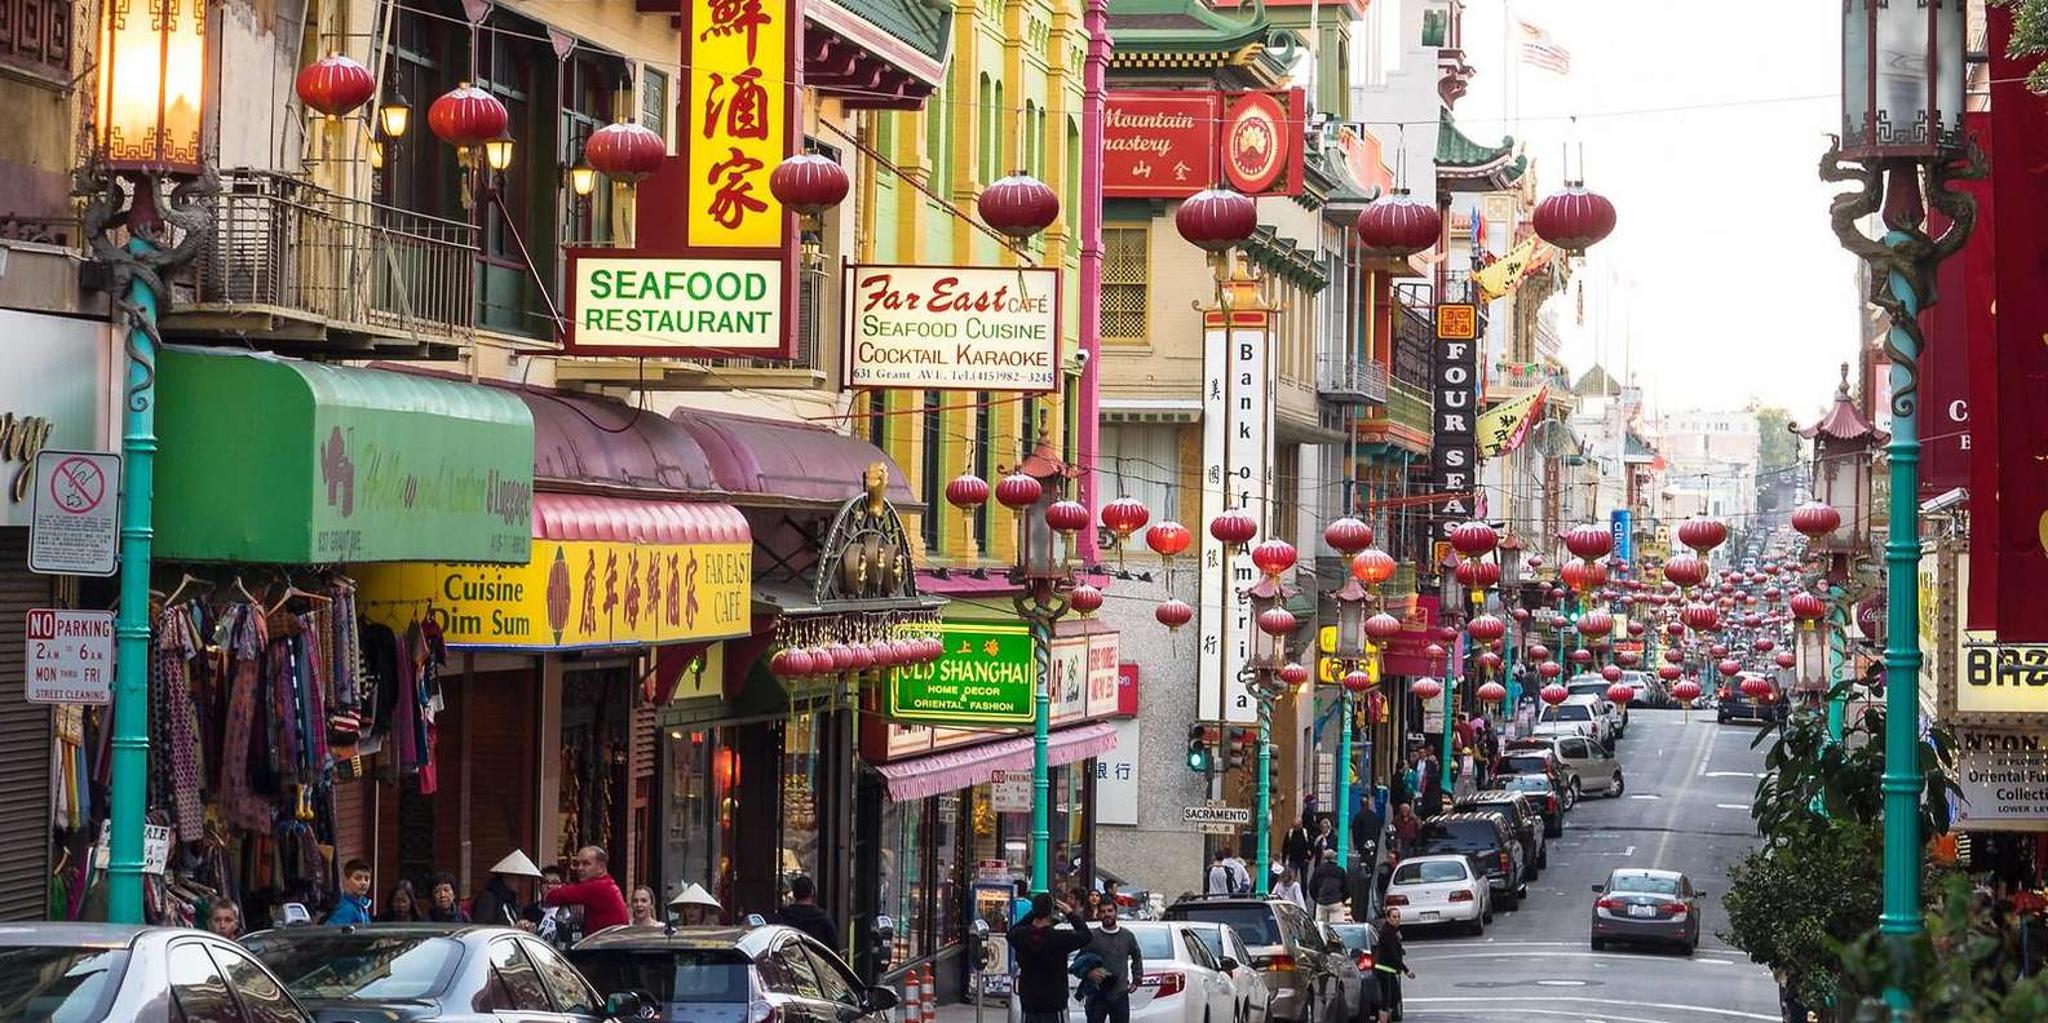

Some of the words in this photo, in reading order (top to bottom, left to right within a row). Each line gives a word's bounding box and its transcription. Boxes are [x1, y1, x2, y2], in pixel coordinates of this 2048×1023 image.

[700, 0, 771, 229] 鮮酒家
[1105, 108, 1194, 129] Mountain
[590, 269, 767, 301] SEAFOOD
[861, 274, 920, 312] Far
[927, 276, 1007, 313] East
[1008, 294, 1048, 314] CAFÉ
[585, 308, 772, 334] RESTAURANT
[854, 368, 871, 379] 631
[876, 370, 910, 379] Grant
[1240, 343, 1253, 439] Bank
[1444, 342, 1468, 432] FOUR
[1239, 466, 1251, 509] of
[705, 552, 724, 585] FAR
[726, 552, 752, 585] EAST
[444, 574, 524, 602] Cuisine
[31, 613, 53, 637] NO
[57, 620, 110, 638] PARKING
[431, 607, 481, 635] Dim
[492, 609, 530, 636] Sum
[1235, 541, 1252, 708] America
[36, 642, 46, 660] 2
[80, 644, 88, 661] 6
[36, 667, 57, 682] MON
[60, 669, 78, 679] THRU
[84, 667, 101, 683] FRI
[940, 660, 1029, 684] SHANGHAI
[36, 689, 63, 700] STREET
[65, 690, 105, 701] CLEANING
[928, 685, 958, 695] HOME
[964, 686, 1000, 696] DECOR
[914, 699, 964, 710] ORIENTAL
[970, 701, 1014, 711] FASHION
[1969, 768, 2025, 783] Oriental
[2030, 770, 2048, 783] Fu
[1184, 808, 1249, 820] SACRAMENTO
